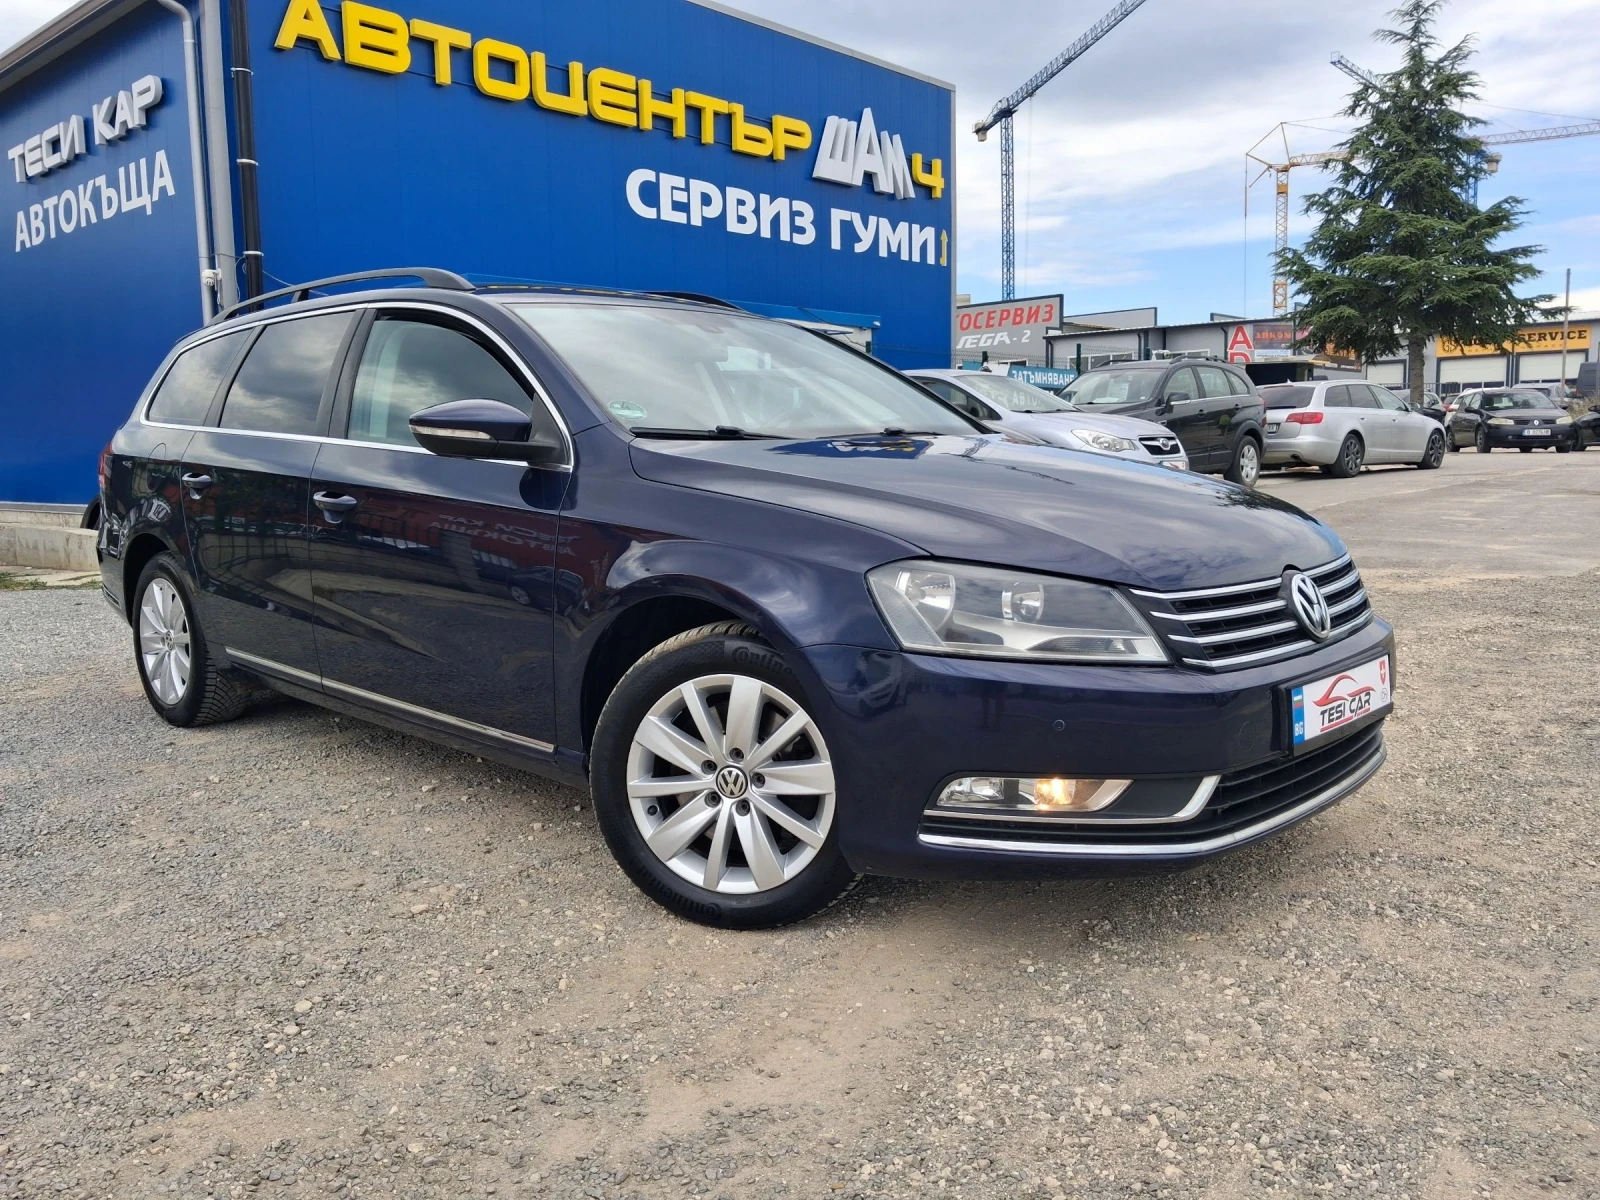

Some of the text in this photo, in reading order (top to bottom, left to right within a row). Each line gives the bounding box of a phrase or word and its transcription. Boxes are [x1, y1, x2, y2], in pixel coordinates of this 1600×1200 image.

[274, 0, 813, 162] АВТОЦЕНТЪР
[812, 107, 916, 200] ШАМ
[8, 74, 163, 183] ТЕСИ КАР
[15, 149, 176, 253] АВТОКЪЩА
[625, 168, 936, 266] СЕРВИЗ ГУМИ
[956, 303, 1054, 331] ОСЕРВИЗ
[1518, 329, 1588, 343] SERVICE
[1011, 370, 1076, 386] ЗАТЪМНЯВАНЕ
[1320, 691, 1371, 727] TESI CAR
[1294, 720, 1304, 737] BG
